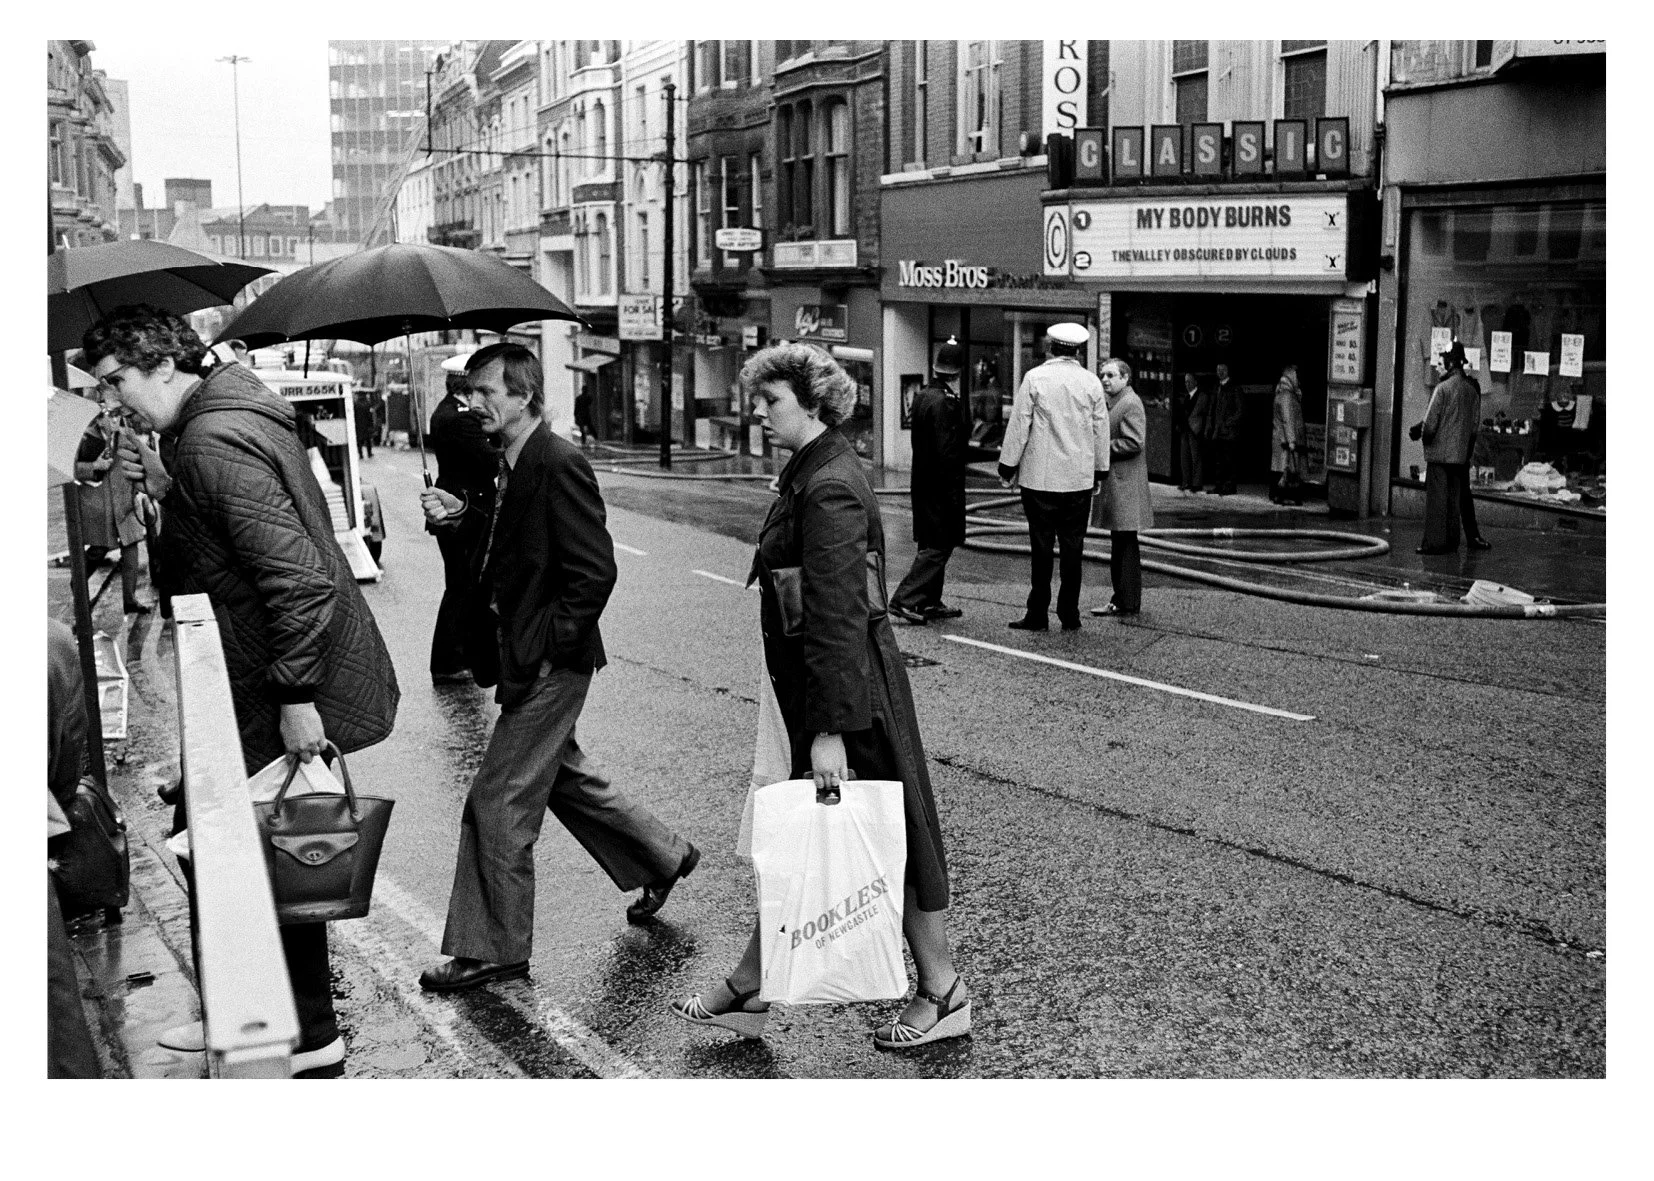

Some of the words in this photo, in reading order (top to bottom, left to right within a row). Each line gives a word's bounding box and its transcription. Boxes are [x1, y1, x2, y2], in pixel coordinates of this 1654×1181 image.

[1079, 129, 1343, 168] CLASSIC
[1136, 208, 1165, 229] MY
[1169, 206, 1221, 229] BODY
[1225, 204, 1292, 228] BURNS
[1324, 210, 1341, 227] X
[1074, 253, 1090, 268] 2
[1173, 247, 1234, 261] OBSCURED
[1250, 247, 1297, 261] CLOUDS
[1324, 253, 1341, 269] X
[898, 259, 943, 287] Moss
[944, 259, 989, 288] Bros
[623, 305, 639, 314] FOR
[305, 384, 336, 395] 565K
[815, 936, 826, 949] OF
[828, 904, 879, 941] NEWCASTLE
